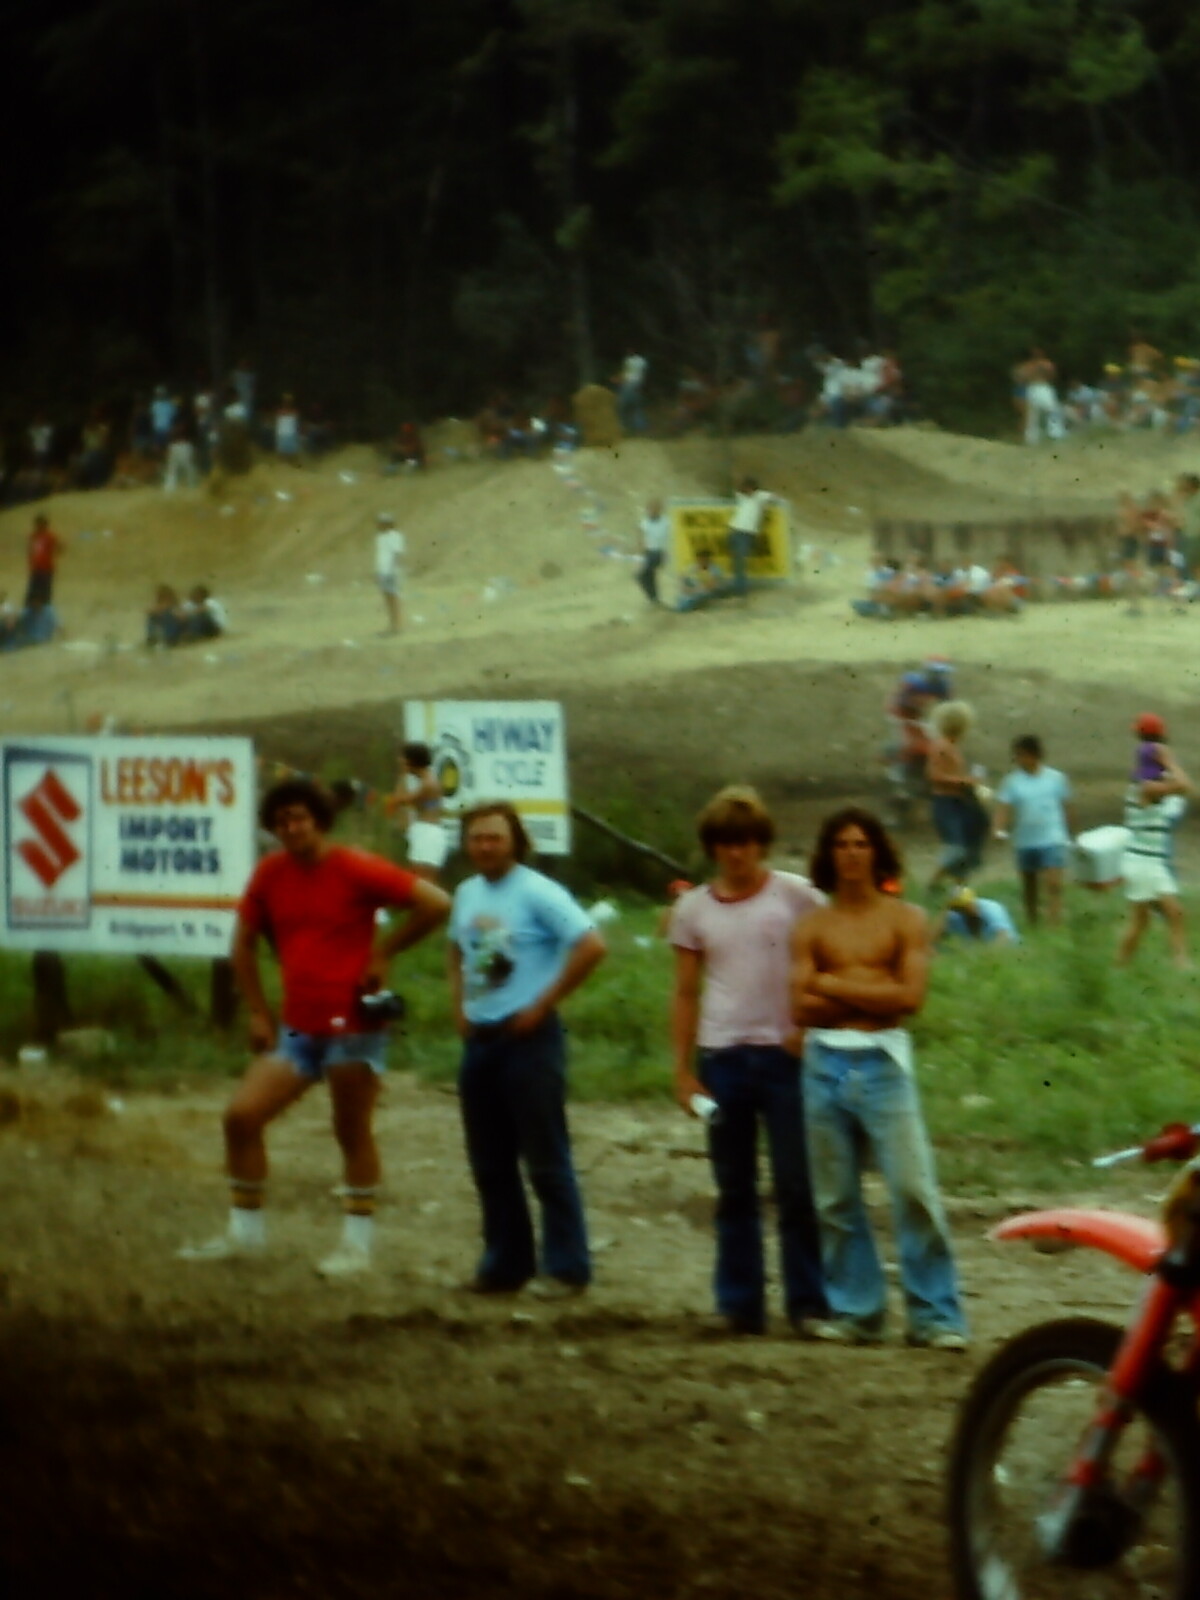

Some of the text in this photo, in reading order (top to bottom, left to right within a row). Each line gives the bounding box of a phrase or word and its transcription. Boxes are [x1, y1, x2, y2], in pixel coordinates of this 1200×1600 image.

[101, 757, 235, 808] LEESON'S
[494, 760, 547, 786] CYCLE
[119, 815, 212, 842] IMPORT
[120, 848, 220, 874] MOTORS
